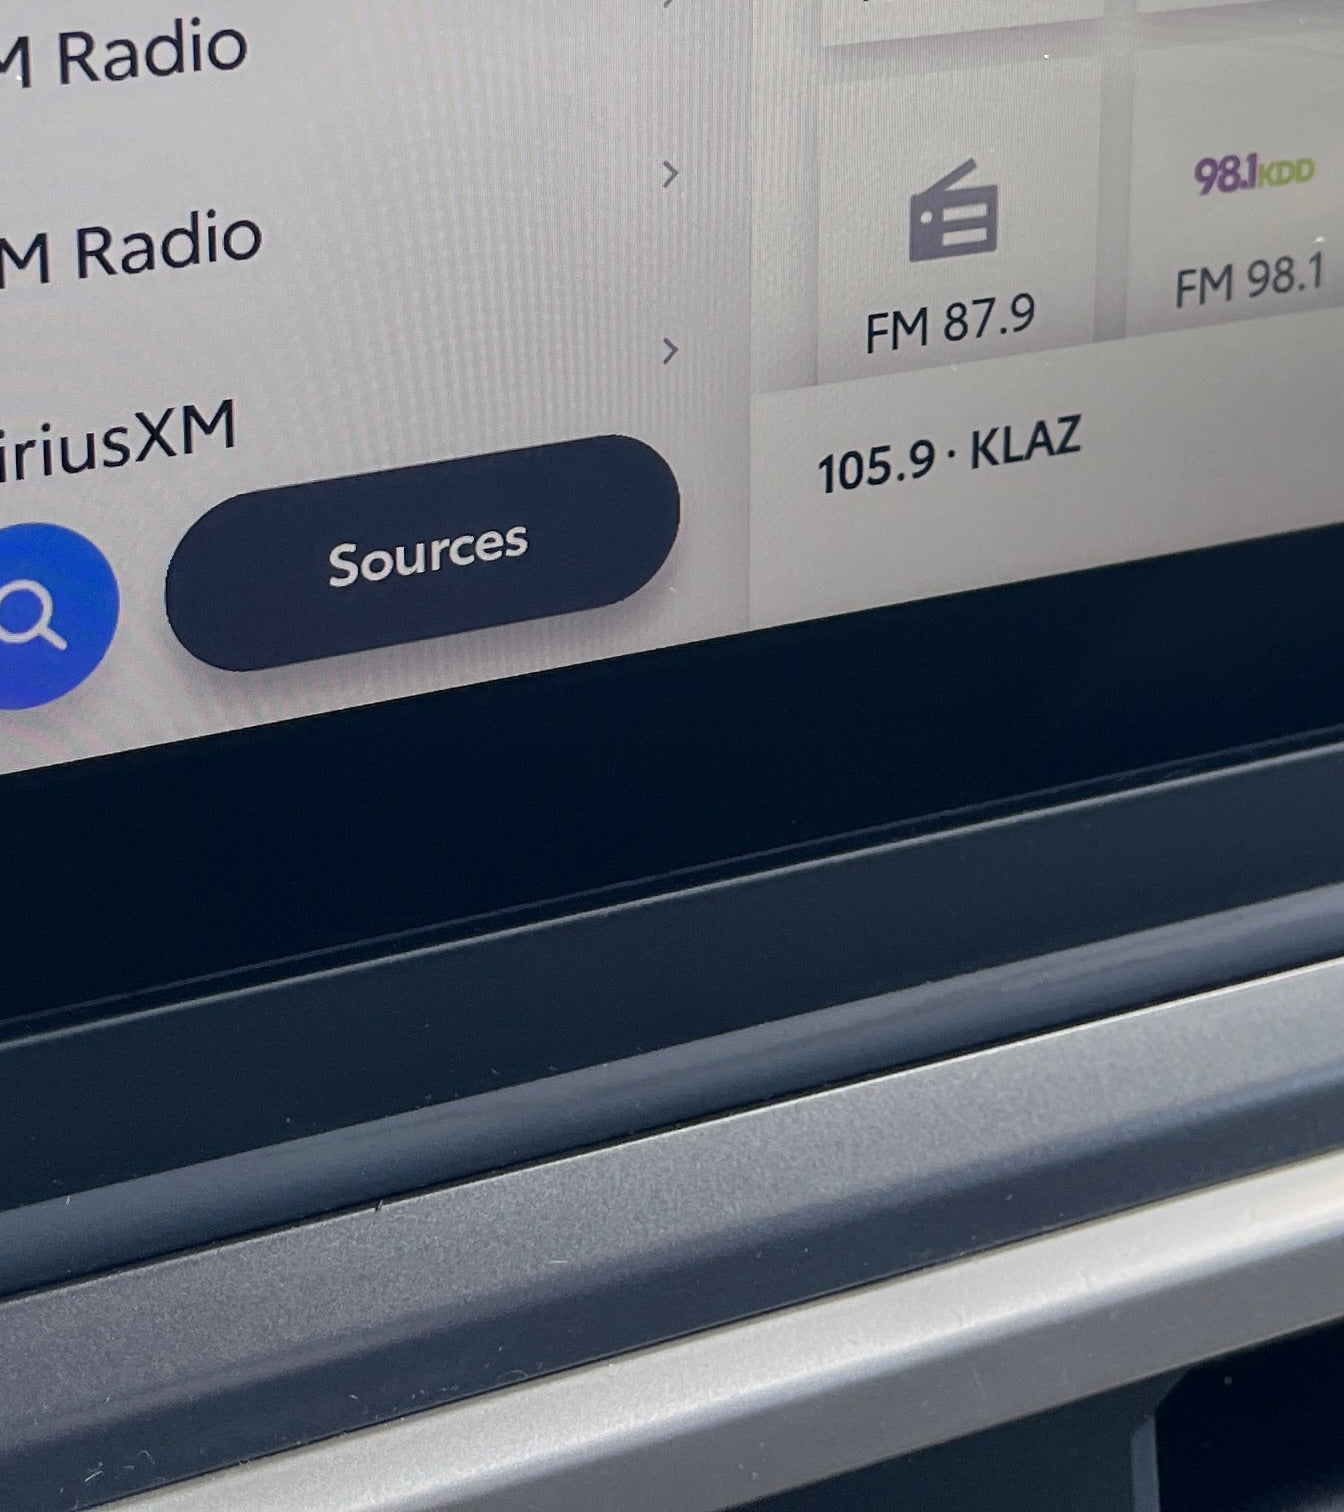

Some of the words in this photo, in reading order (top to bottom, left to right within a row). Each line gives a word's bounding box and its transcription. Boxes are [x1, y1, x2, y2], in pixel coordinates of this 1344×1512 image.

[58, 16, 247, 85] Radio
[76, 208, 262, 279] Radio
[1176, 263, 1234, 309] FM
[1247, 251, 1323, 299] 98.1
[867, 305, 928, 355] FM
[943, 292, 1036, 342] 87.9
[818, 439, 936, 494] 105.9
[971, 414, 1082, 470] KLAZ
[329, 526, 528, 588] Sources
